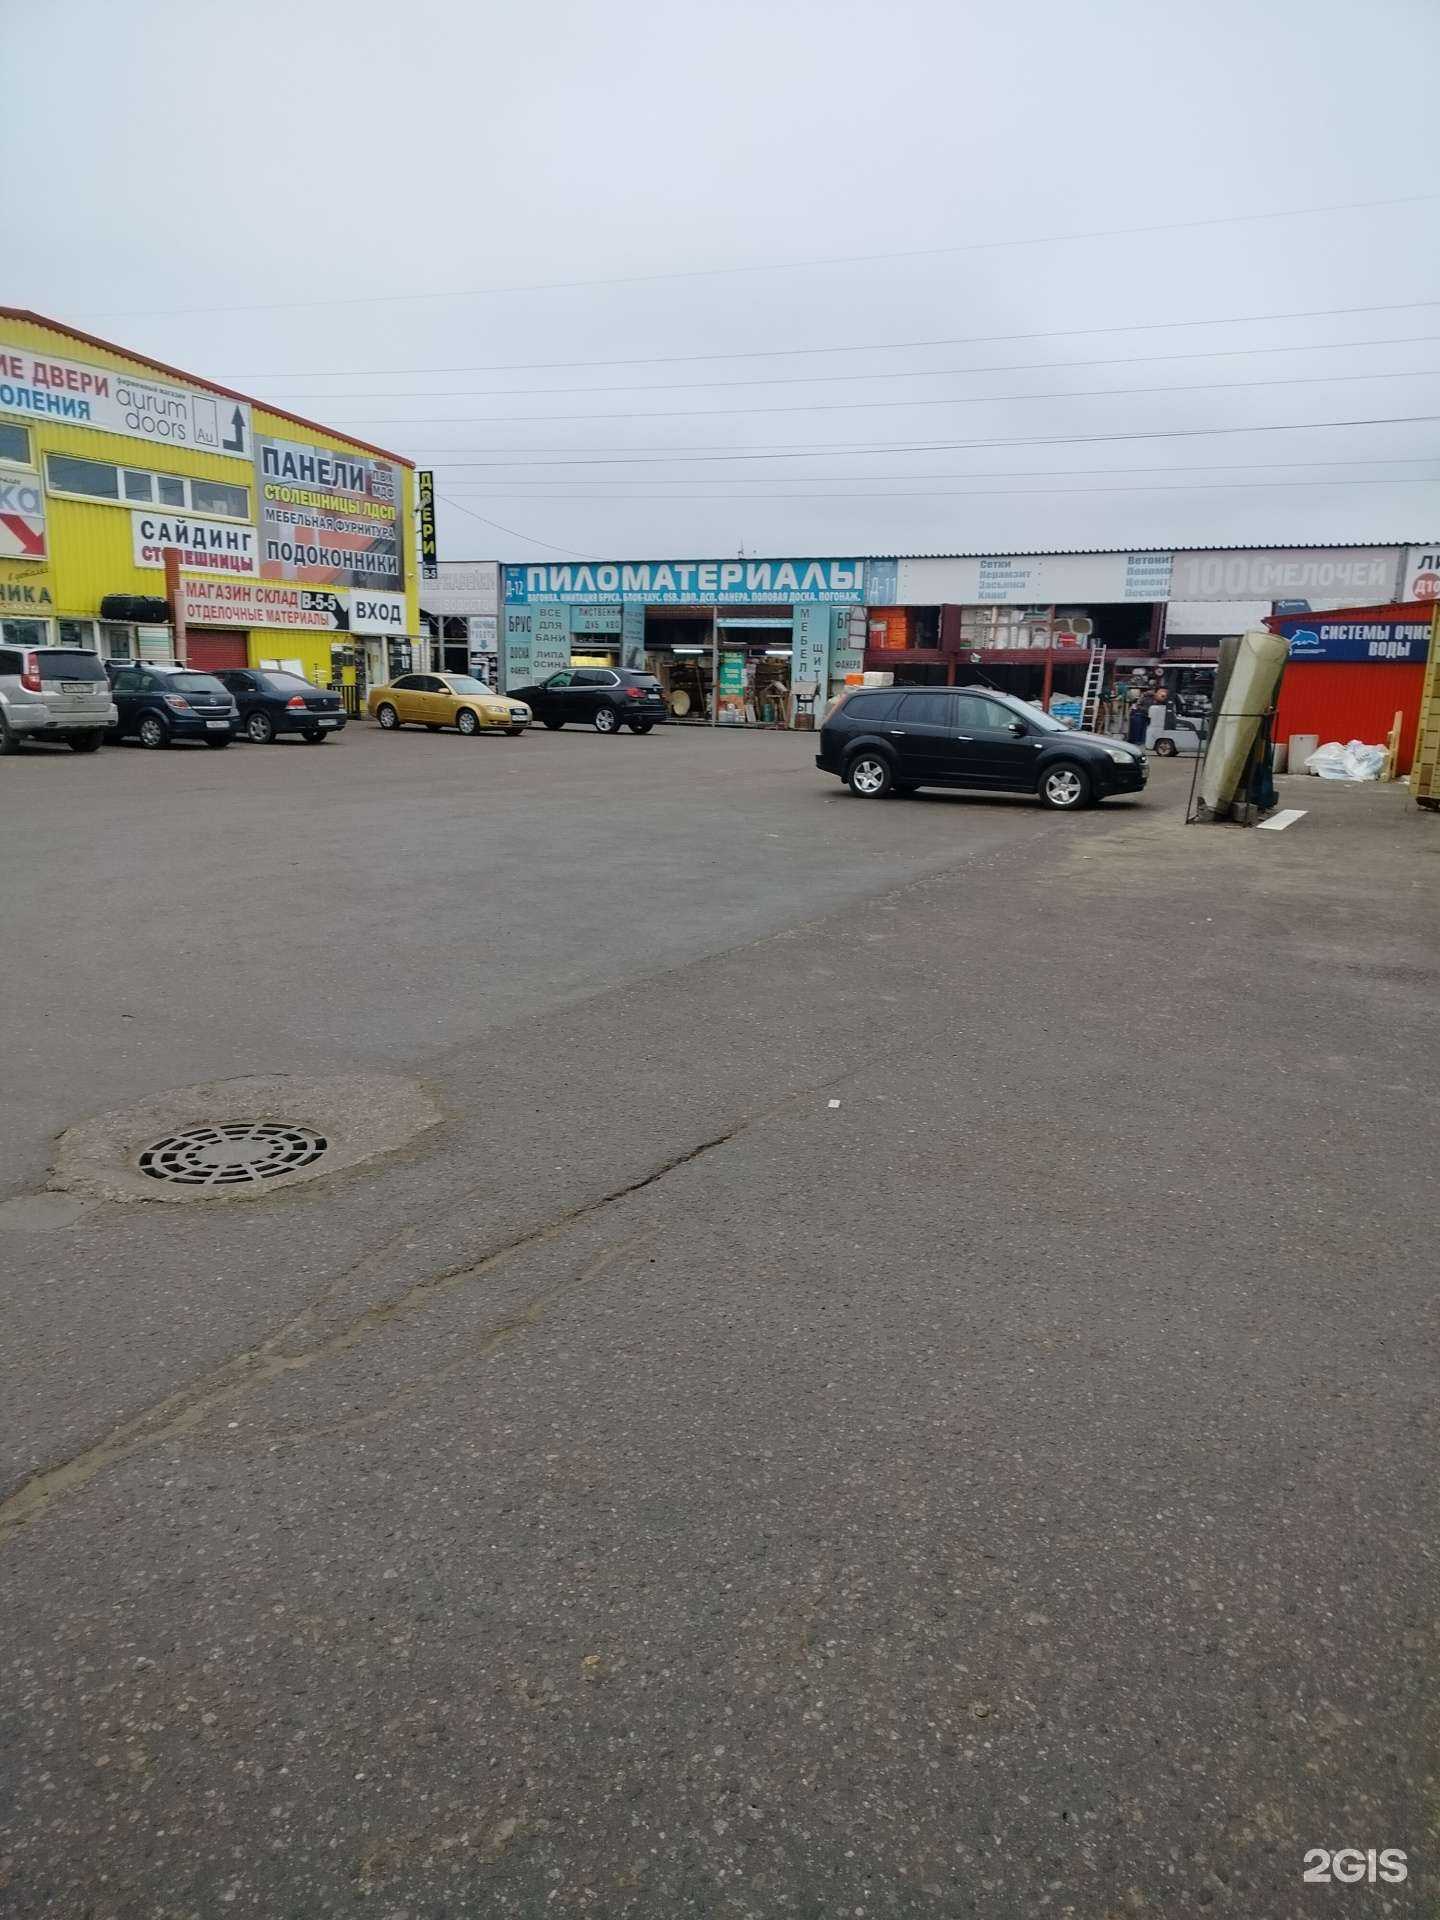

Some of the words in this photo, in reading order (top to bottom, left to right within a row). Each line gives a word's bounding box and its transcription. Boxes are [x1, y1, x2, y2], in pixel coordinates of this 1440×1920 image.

[32, 361, 109, 398] ДВЕРИ
[0, 384, 91, 420] ОЛЕНИЯ
[116, 388, 187, 420] aurum
[125, 409, 186, 440] doors
[198, 427, 214, 443] Au
[262, 446, 365, 492] ПАНЕЛИ
[373, 470, 393, 482] ПВХ
[264, 484, 361, 515] СТОЛЕШНИЦЫ
[363, 501, 396, 521] ЛДСП
[373, 484, 395, 499] МДФ
[265, 508, 333, 530] МЕБЕЛЬНАЯ
[334, 518, 395, 540] ФУРНИТУРА
[420, 472, 436, 554] ДВЕРИ
[140, 519, 251, 551] САЙДИНГ
[142, 546, 253, 572] СТЕШНИЦЫ
[267, 540, 398, 575] ПОДОКОННИКИ
[980, 560, 1011, 568] Сетки
[527, 562, 864, 593] ПИЛОМАТЕРИАЛЫ
[1261, 559, 1387, 587] МЕЛОЧЕЙ
[186, 581, 251, 602] МАГАЗИН
[256, 588, 298, 608] СКЛАД
[302, 592, 337, 611] В-5-5
[871, 577, 896, 596] Д-11
[187, 603, 263, 621] ОТДЕЛОЧНЫЕ
[266, 609, 330, 626] МАТЕРИАЛЫ
[356, 601, 401, 624] ВХОД
[509, 615, 532, 633] БРУС
[539, 621, 562, 630] ДЛЯ
[540, 608, 561, 617] ВСЕ
[535, 633, 566, 642] БАНИ
[1320, 625, 1391, 641] СИСТЕМЫ
[537, 651, 565, 659] ЛИПА
[1368, 641, 1410, 659] ВОДЫ
[533, 660, 568, 669] ОСИНА
[813, 643, 822, 684] ЩИТ
